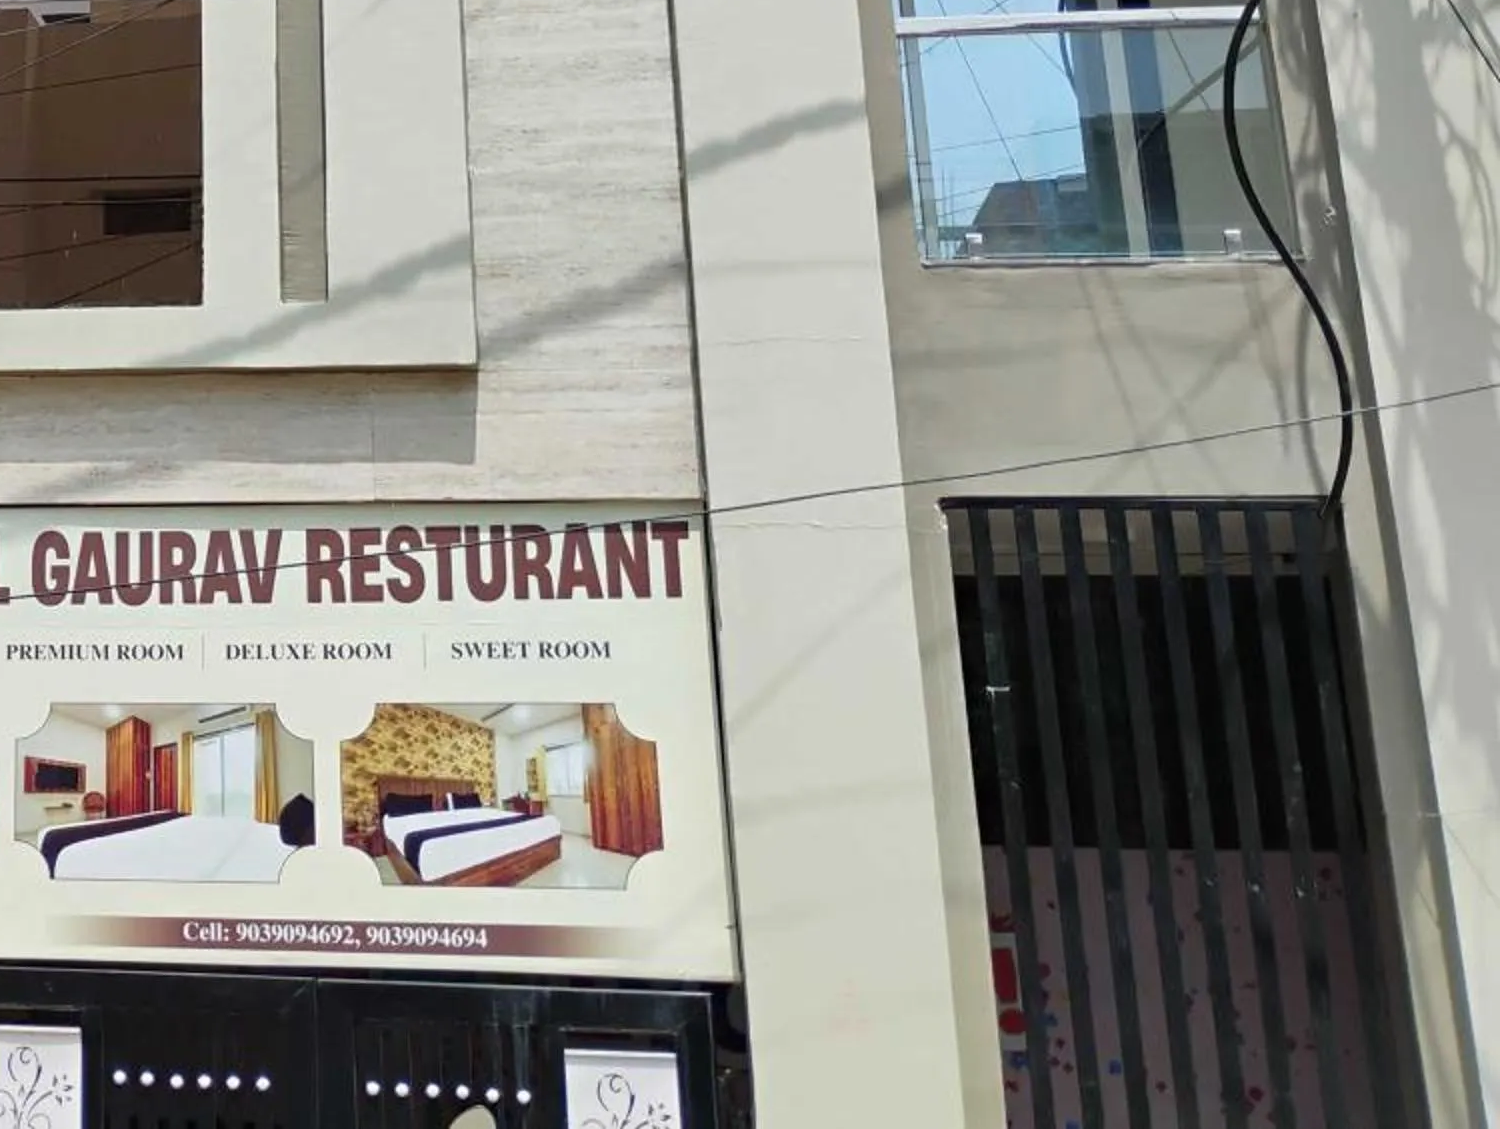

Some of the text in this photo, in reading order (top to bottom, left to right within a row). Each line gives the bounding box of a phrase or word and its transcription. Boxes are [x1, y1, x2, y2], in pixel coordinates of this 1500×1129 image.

[30, 527, 283, 607] GAURAV
[305, 520, 689, 604] RESTURANT
[6, 643, 184, 661] PREMIUM ROOM
[225, 642, 393, 661] DELUXE ROOM
[451, 640, 612, 660] SWEET ROOM
[182, 921, 489, 949] Cell: 9039094692, 9039094694
